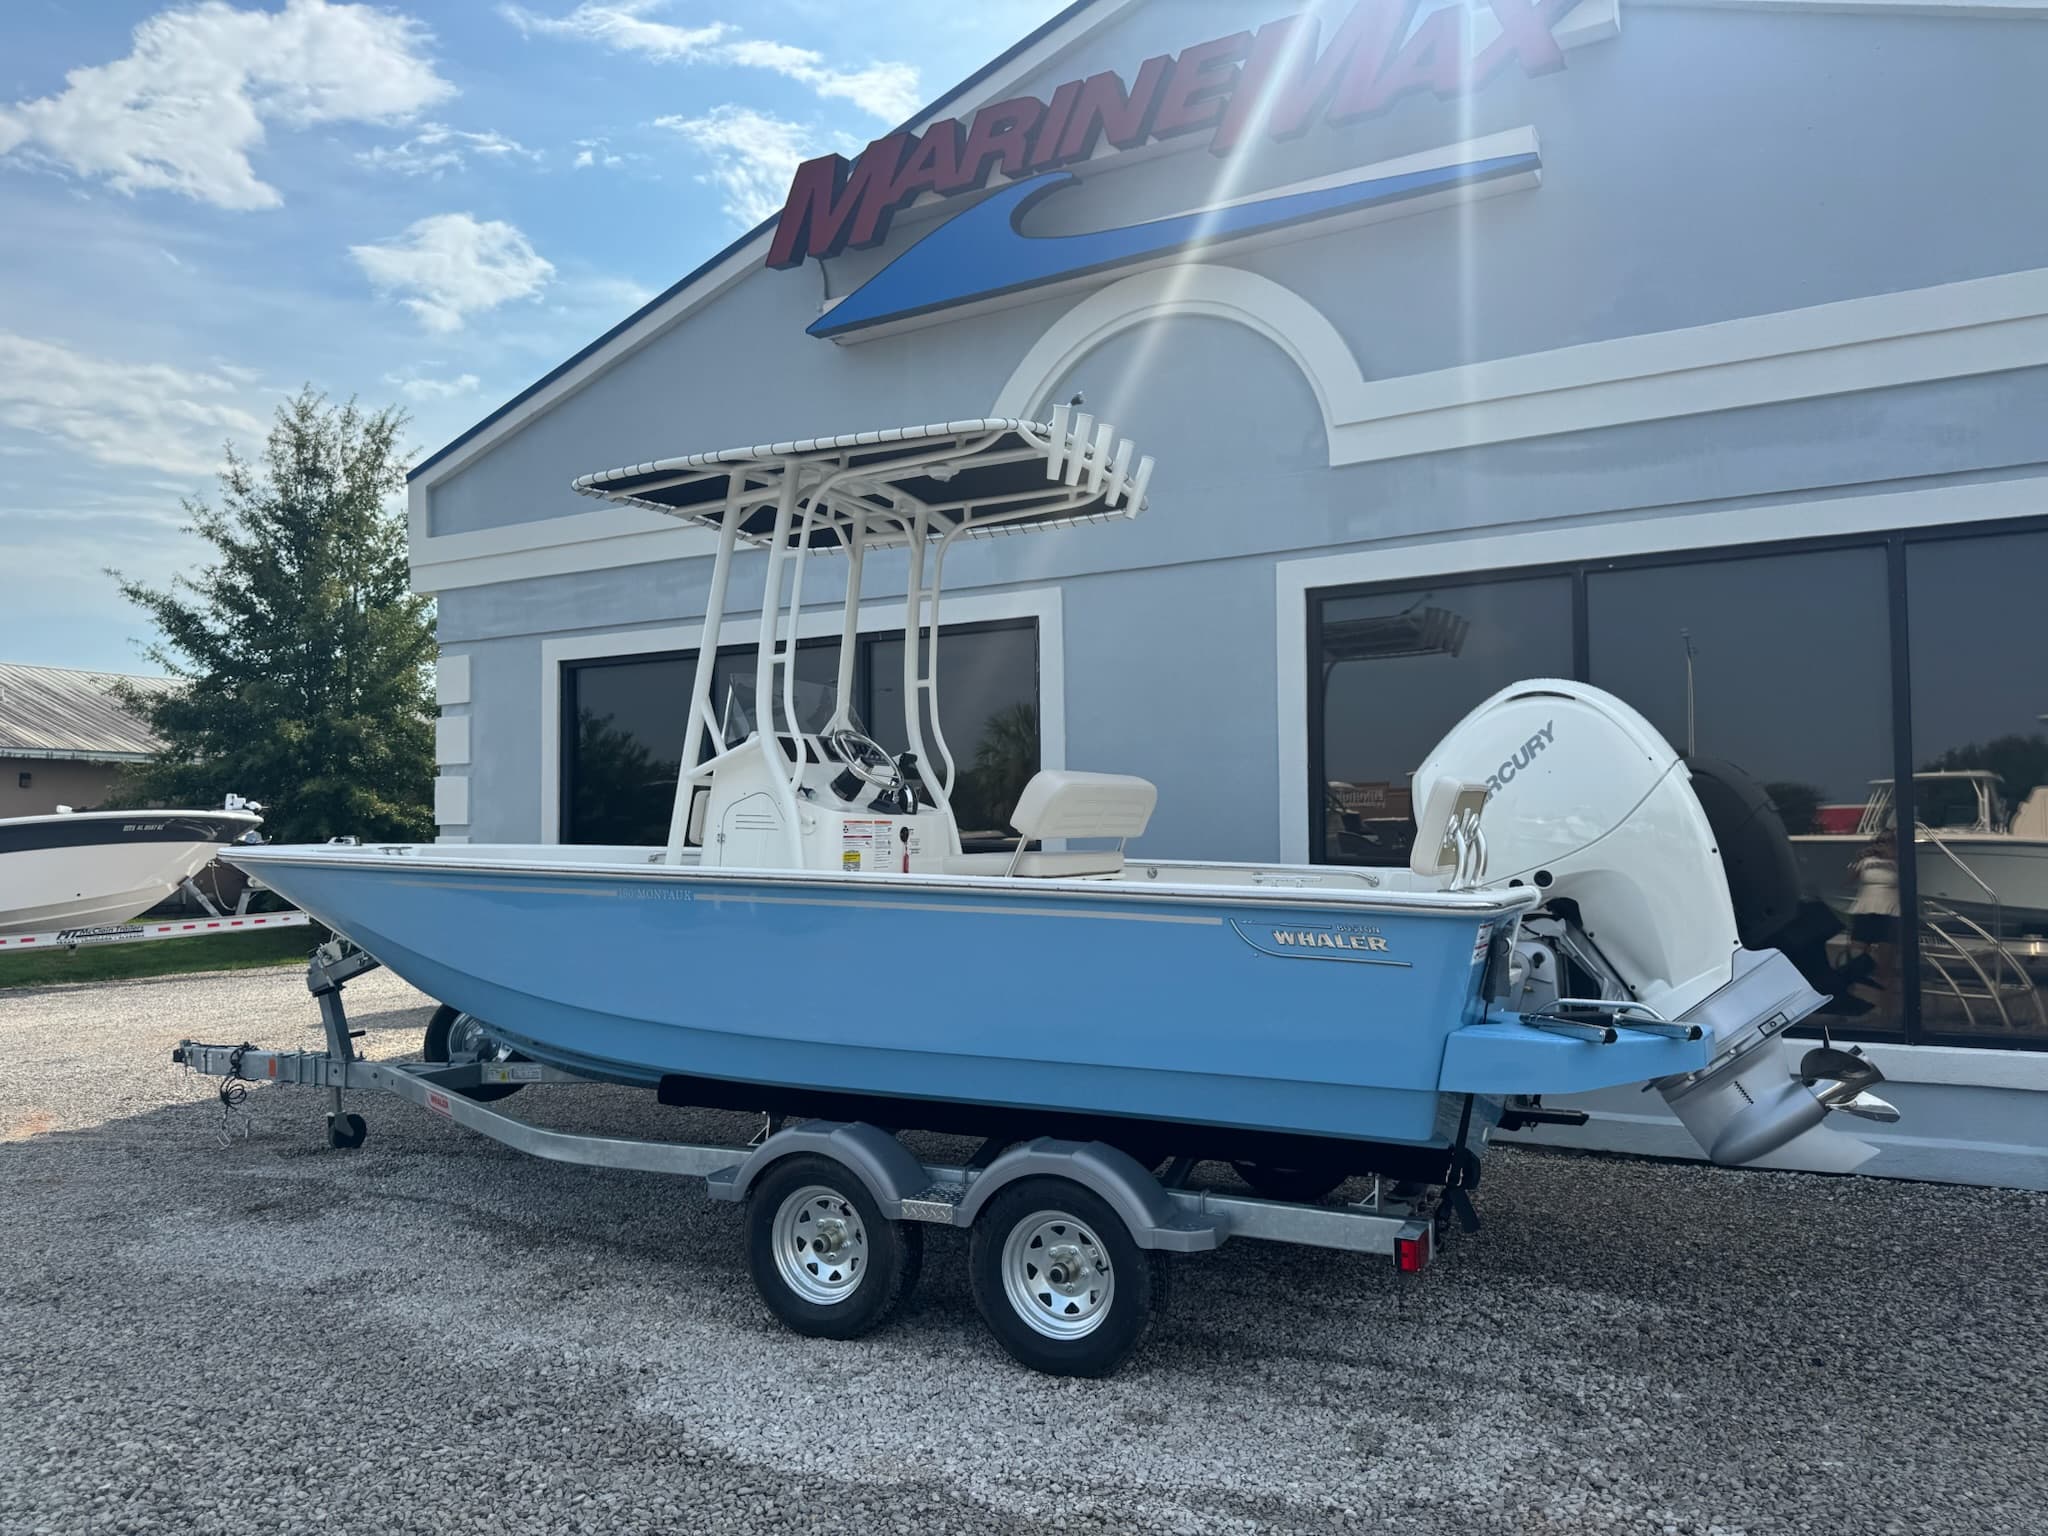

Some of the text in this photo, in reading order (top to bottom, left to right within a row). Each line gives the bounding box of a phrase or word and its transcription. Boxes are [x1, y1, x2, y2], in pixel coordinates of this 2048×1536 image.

[1485, 719, 1554, 801] RCURY
[637, 887, 692, 901] MONTAUK
[1335, 924, 1381, 935] BOSTON
[1272, 929, 1391, 952] WHALER
